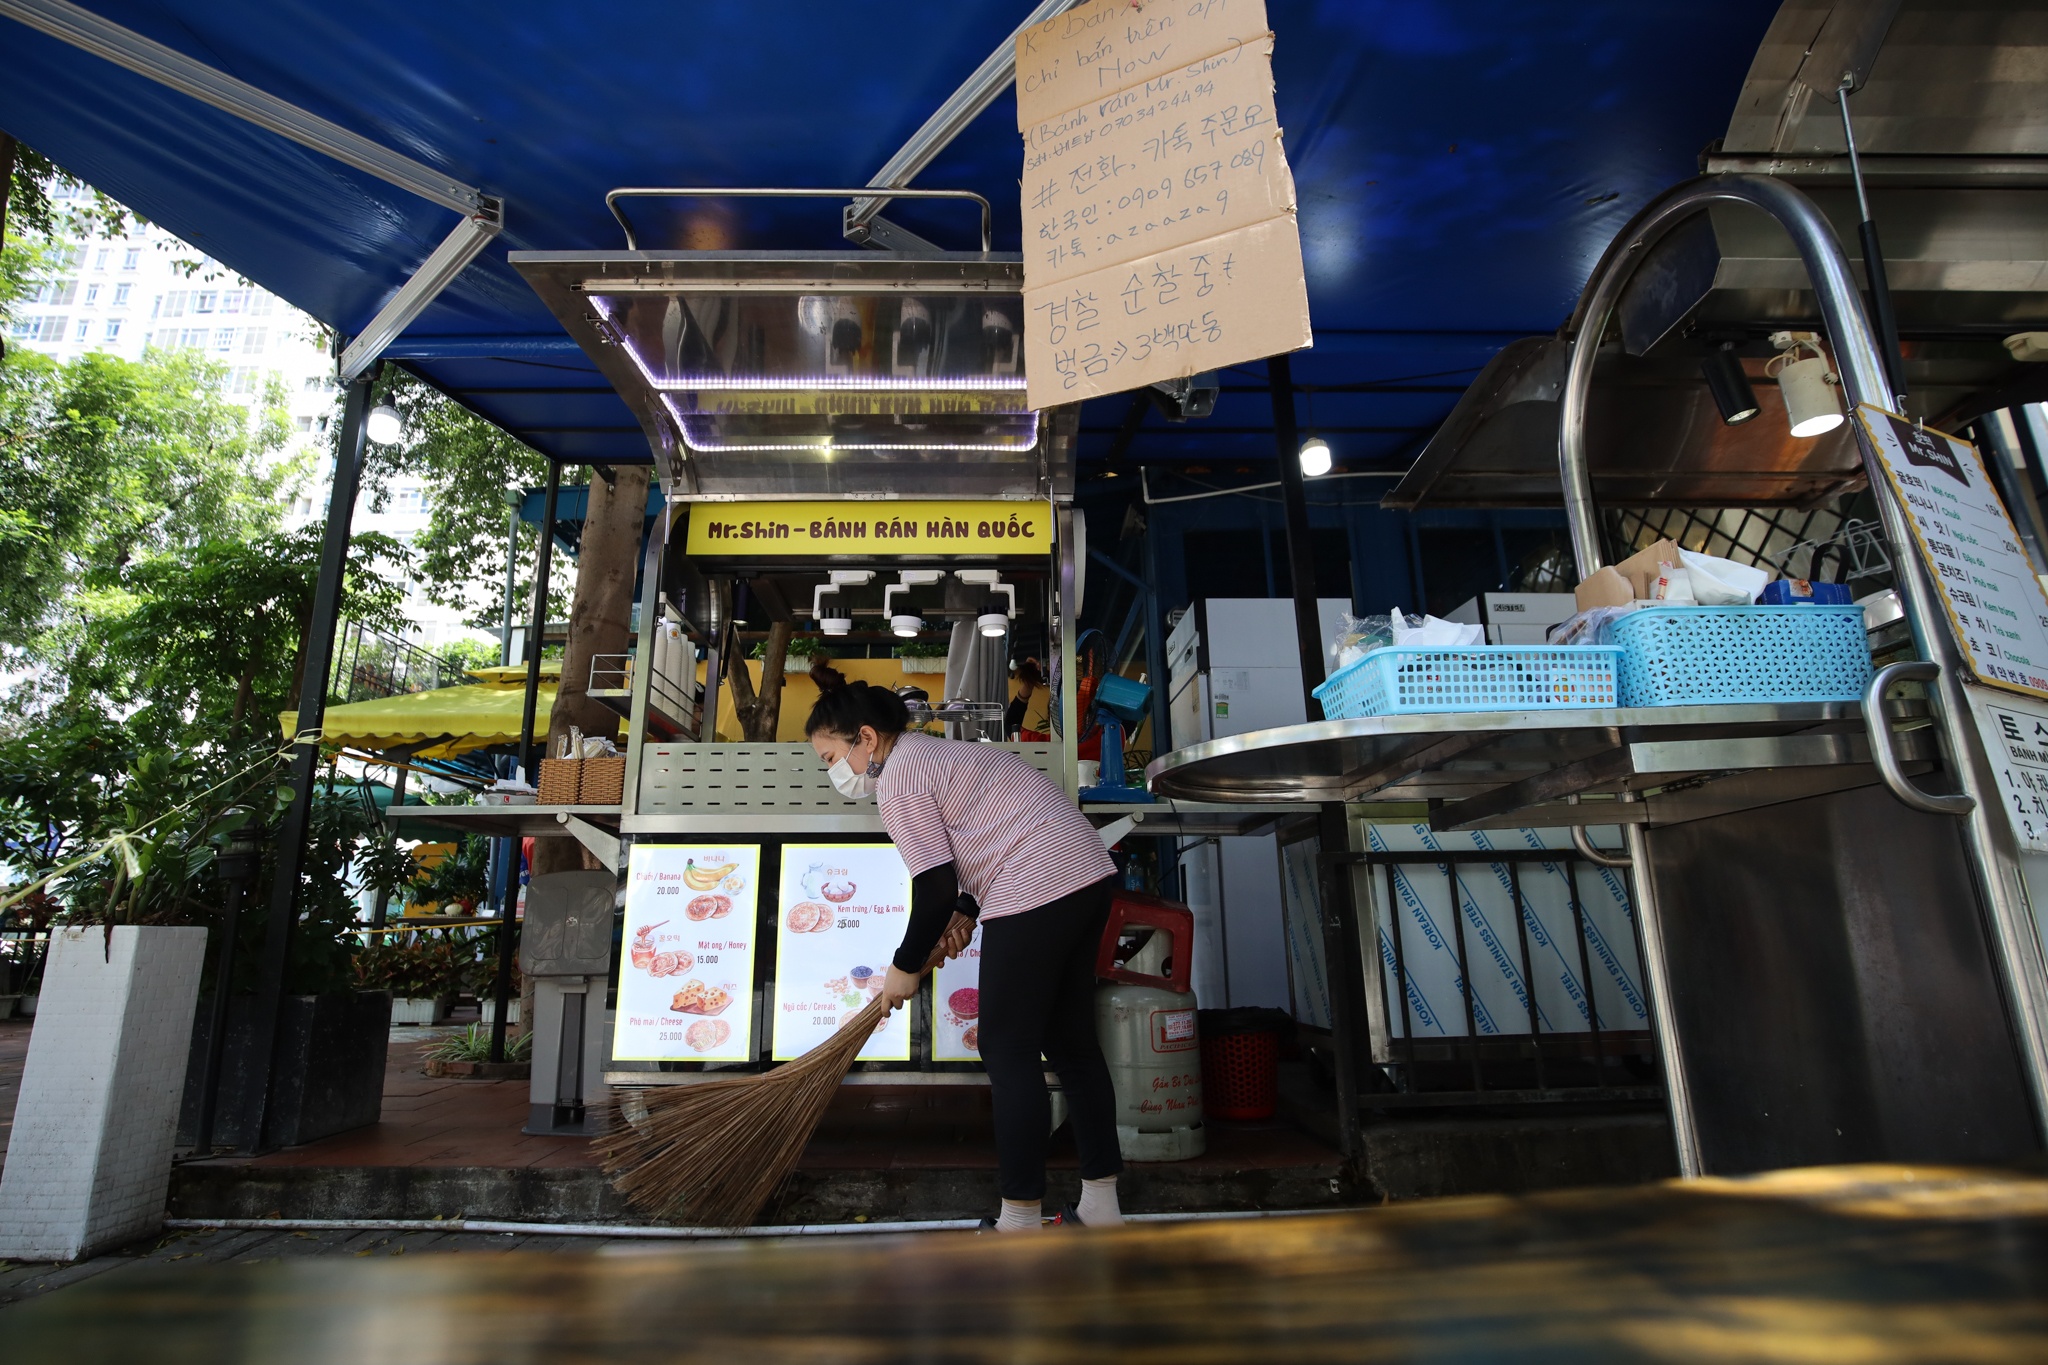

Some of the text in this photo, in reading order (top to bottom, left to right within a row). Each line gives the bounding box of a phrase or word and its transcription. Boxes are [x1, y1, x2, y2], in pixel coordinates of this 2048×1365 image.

[1186, 37, 1243, 78] Shin)
[1142, 121, 1193, 162] 카톡
[1184, 160, 1223, 189] 657
[1230, 139, 1266, 175] 089
[1034, 288, 1100, 346] 경찰
[1120, 261, 1184, 316] 순찰
[1907, 441, 1954, 468] Mr. SHIN
[1905, 492, 1935, 513] 바나나
[874, 516, 918, 539] RÁN
[926, 516, 969, 539] HÀN
[977, 512, 1036, 539] QUỐC
[1937, 561, 1966, 581] 콘치즈
[1949, 587, 1977, 608] 슈크림
[2009, 745, 2039, 762] BÁNH
[2013, 793, 2031, 814] 2.
[2023, 820, 2040, 840] 3.
[659, 872, 682, 881] Banana
[1392, 866, 1416, 908] STAINL
[656, 886, 681, 895] 20.000
[837, 904, 851, 913] Kem
[873, 904, 885, 914] Egg
[892, 904, 905, 913] milk
[1462, 900, 1483, 929] STEEL
[1412, 907, 1443, 950] KOREAN
[1519, 905, 1548, 948] KOREAN
[728, 940, 747, 951] Honey
[1479, 927, 1513, 980] STAINLESS
[697, 955, 719, 964] 15.000
[1559, 971, 1581, 1000] STEEL
[813, 1001, 837, 1011] Cereals
[1404, 982, 1433, 1028] KOREAN
[1612, 973, 1647, 1020] KOREAN
[660, 1016, 683, 1026] Cheese
[812, 1016, 836, 1025] 20.000
[659, 1031, 683, 1041] 25.000
